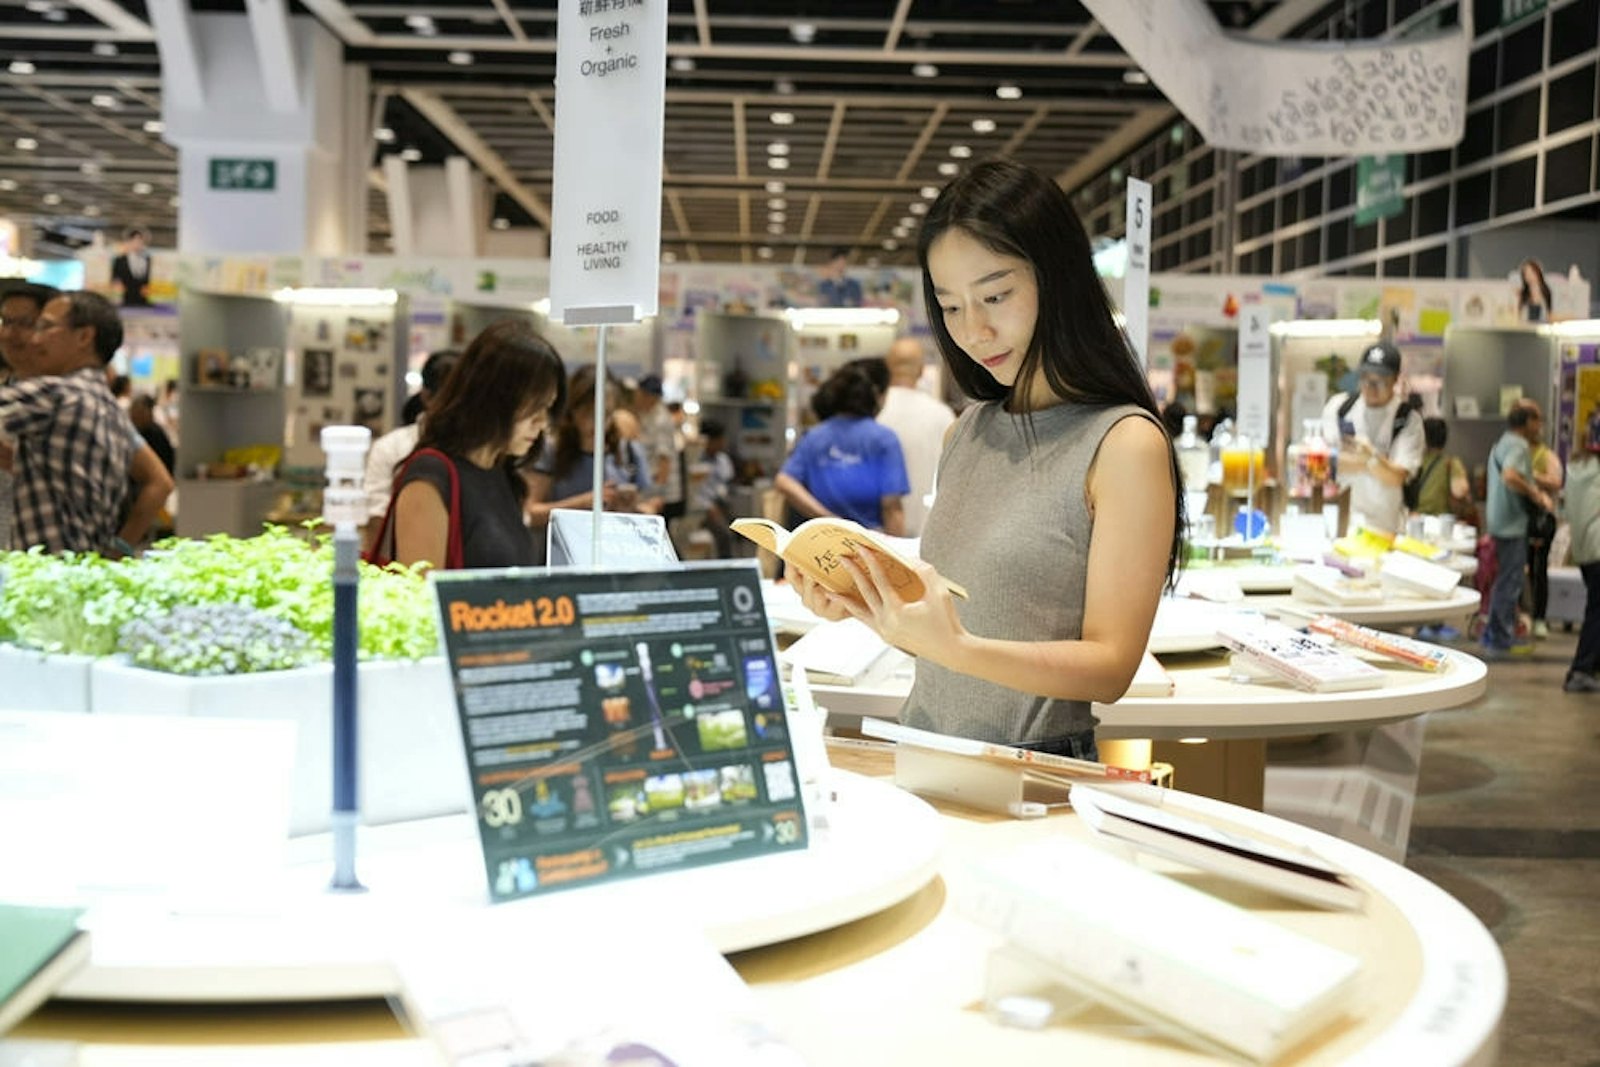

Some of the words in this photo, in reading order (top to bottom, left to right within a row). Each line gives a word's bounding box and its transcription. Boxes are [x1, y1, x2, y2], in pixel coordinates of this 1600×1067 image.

[590, 21, 630, 42] Fresh
[580, 53, 637, 77] Organic
[586, 210, 619, 224] FOOD
[577, 240, 629, 256] HEALTHY
[583, 256, 621, 270] LIVING
[450, 600, 536, 632] Rocket
[538, 595, 575, 626] 2.0
[482, 787, 522, 828] 30
